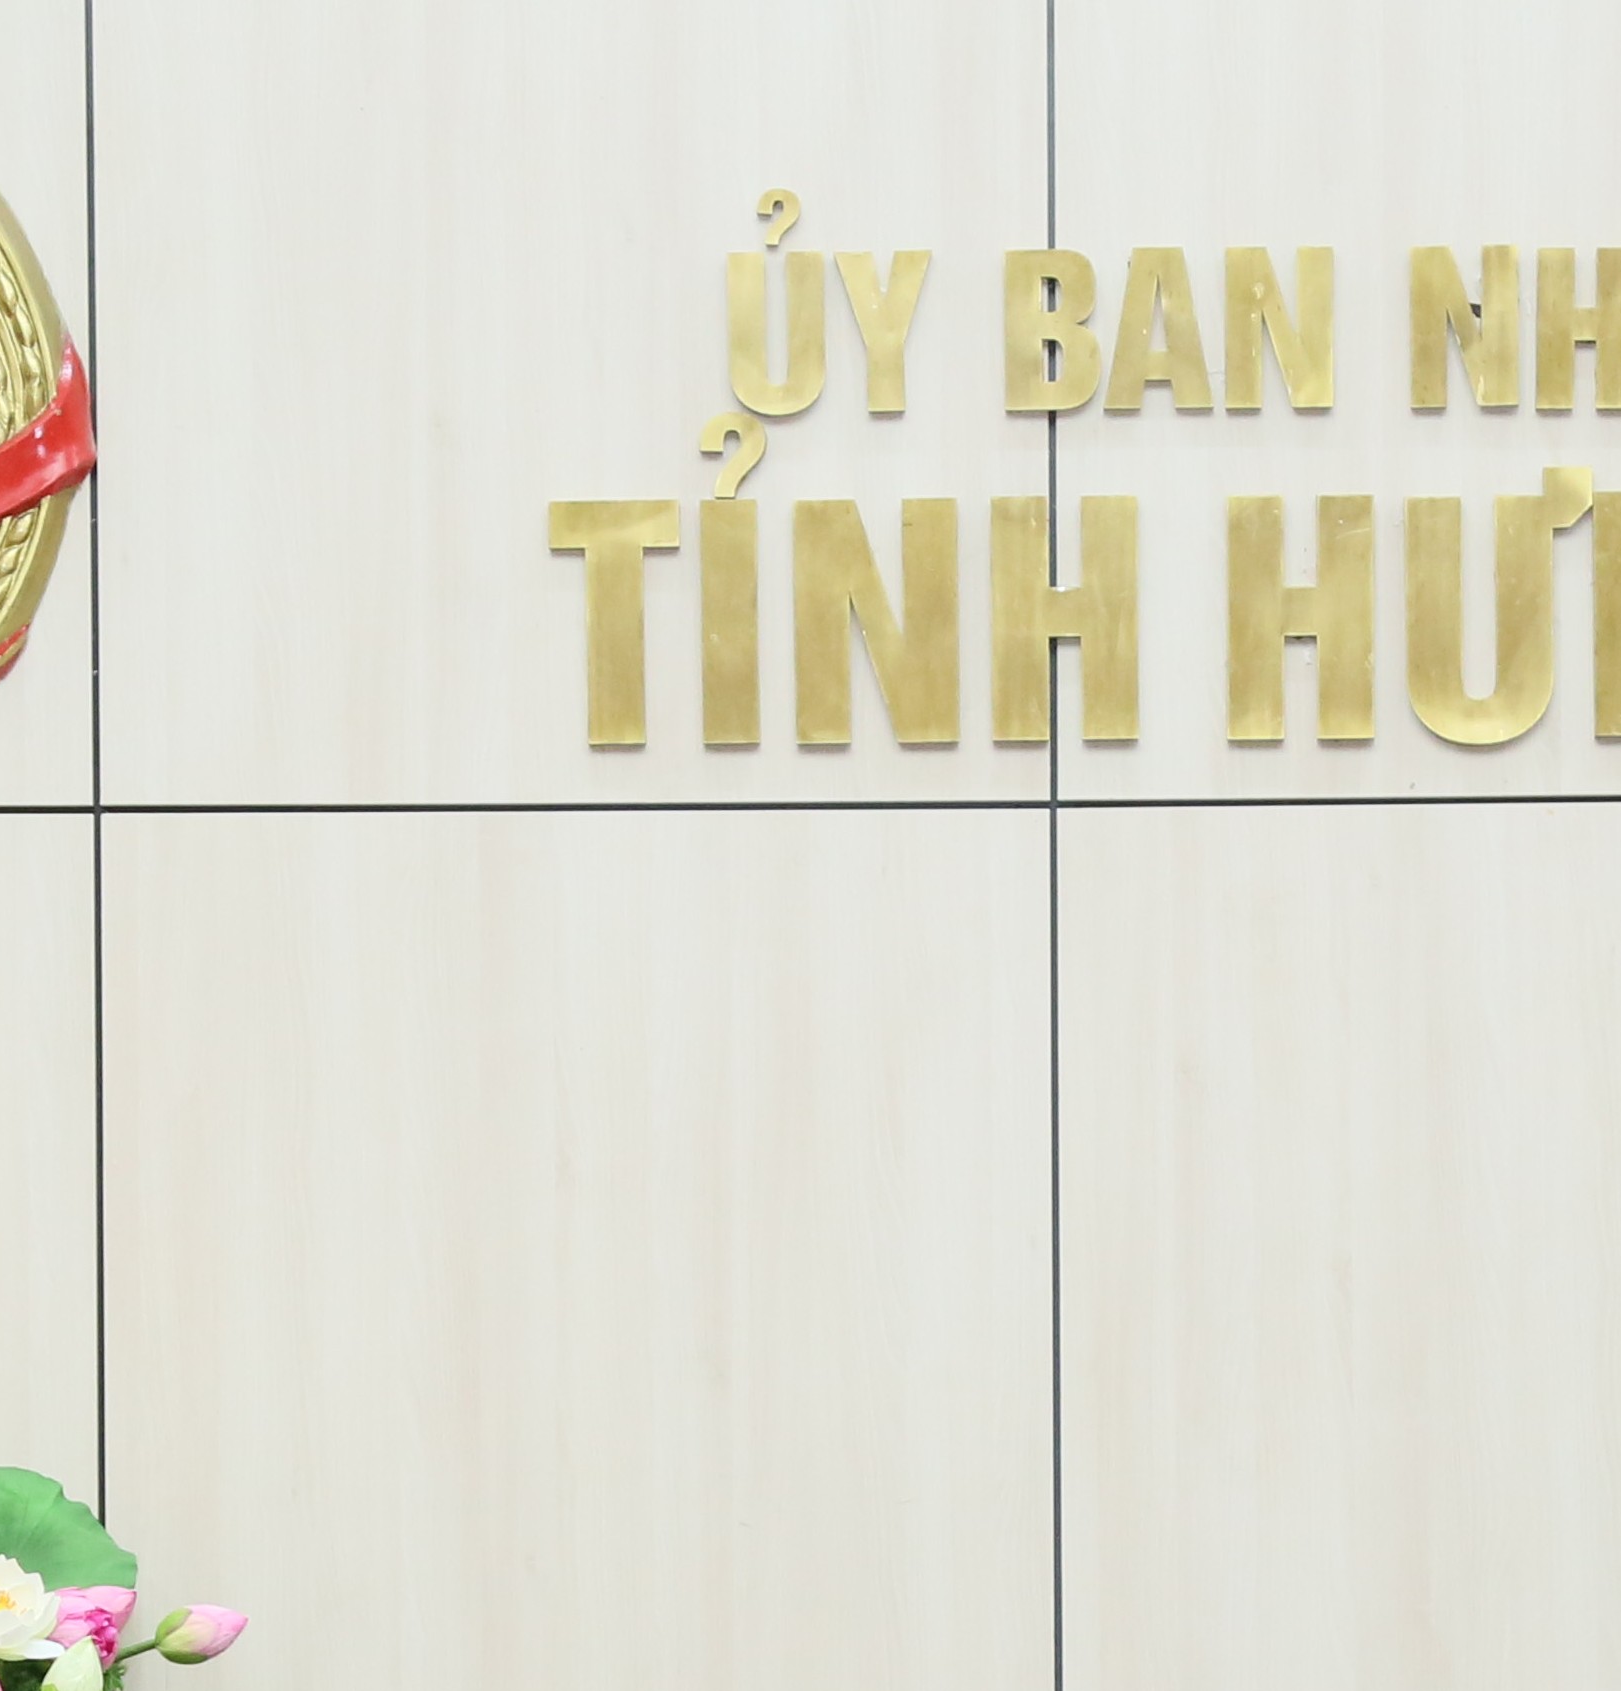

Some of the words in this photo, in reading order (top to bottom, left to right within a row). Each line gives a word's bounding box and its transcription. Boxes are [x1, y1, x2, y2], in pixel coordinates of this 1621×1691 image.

[727, 189, 931, 416] ỦY
[1004, 246, 1335, 413] BAN
[548, 412, 1143, 752] TỈNH
